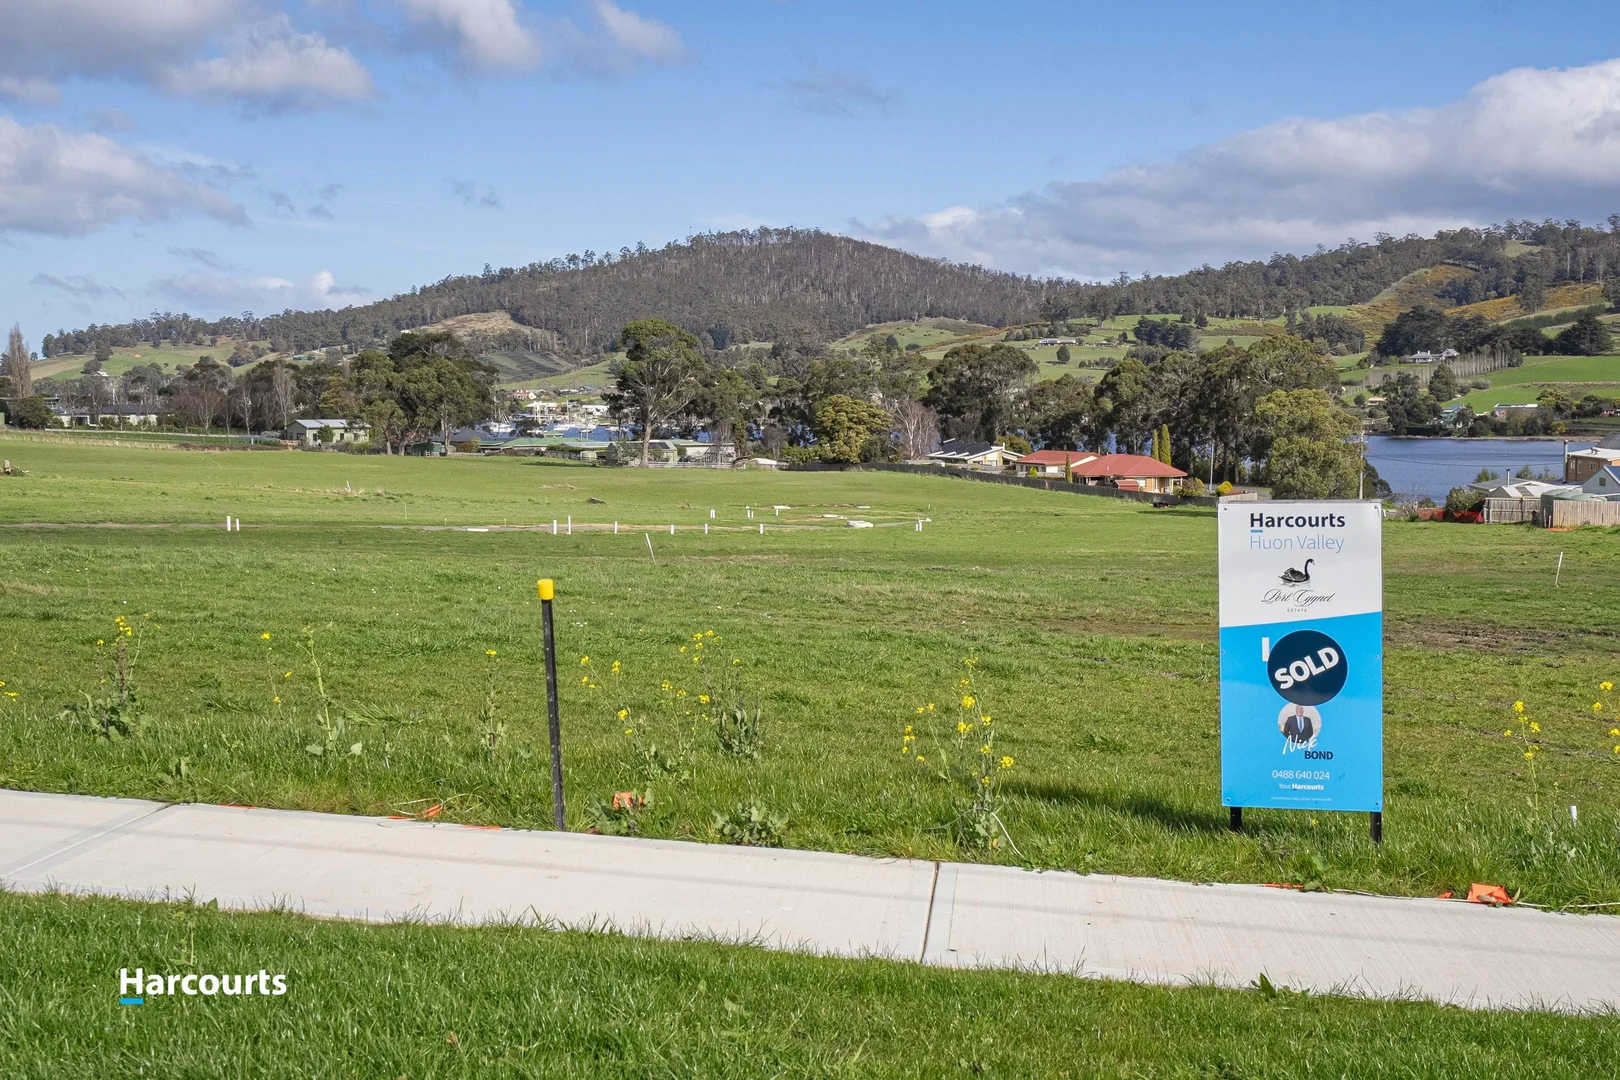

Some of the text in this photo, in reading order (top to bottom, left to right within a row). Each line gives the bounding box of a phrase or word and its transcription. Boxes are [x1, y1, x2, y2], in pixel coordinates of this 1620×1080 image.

[1250, 513, 1346, 528] Harcourts
[1250, 534, 1345, 553] Huon Valley
[1261, 588, 1336, 607] Port Cygnet
[1274, 647, 1340, 690] SOLD
[1282, 732, 1319, 755] Nick
[1304, 751, 1334, 760] BOND
[1271, 770, 1330, 780] 0488 640 024
[1292, 783, 1325, 791] Harcourts
